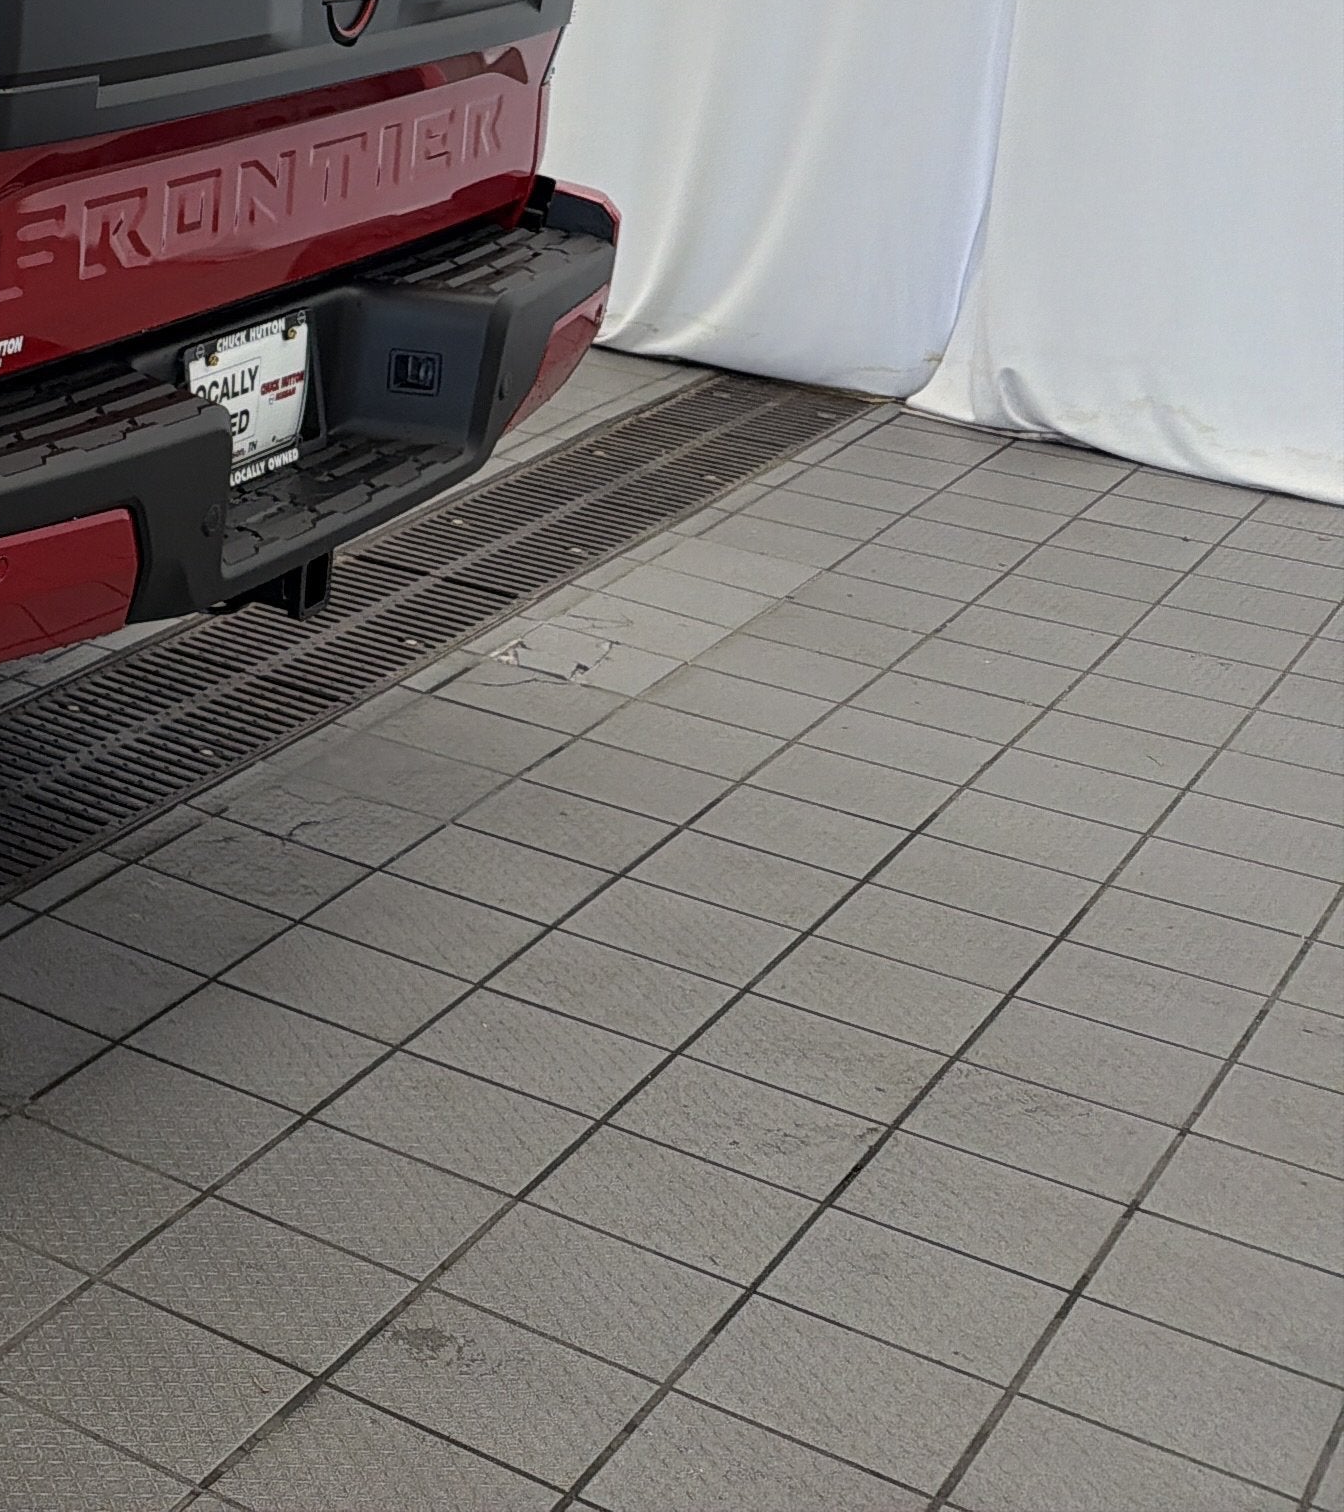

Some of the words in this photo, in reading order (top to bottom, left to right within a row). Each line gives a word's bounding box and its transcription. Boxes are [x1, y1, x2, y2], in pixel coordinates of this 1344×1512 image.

[216, 330, 247, 353] CHUCK
[250, 318, 286, 341] HUTTON
[196, 365, 259, 403] OCALLY
[229, 461, 266, 487] LOCALLY
[267, 448, 299, 470] OWNED
